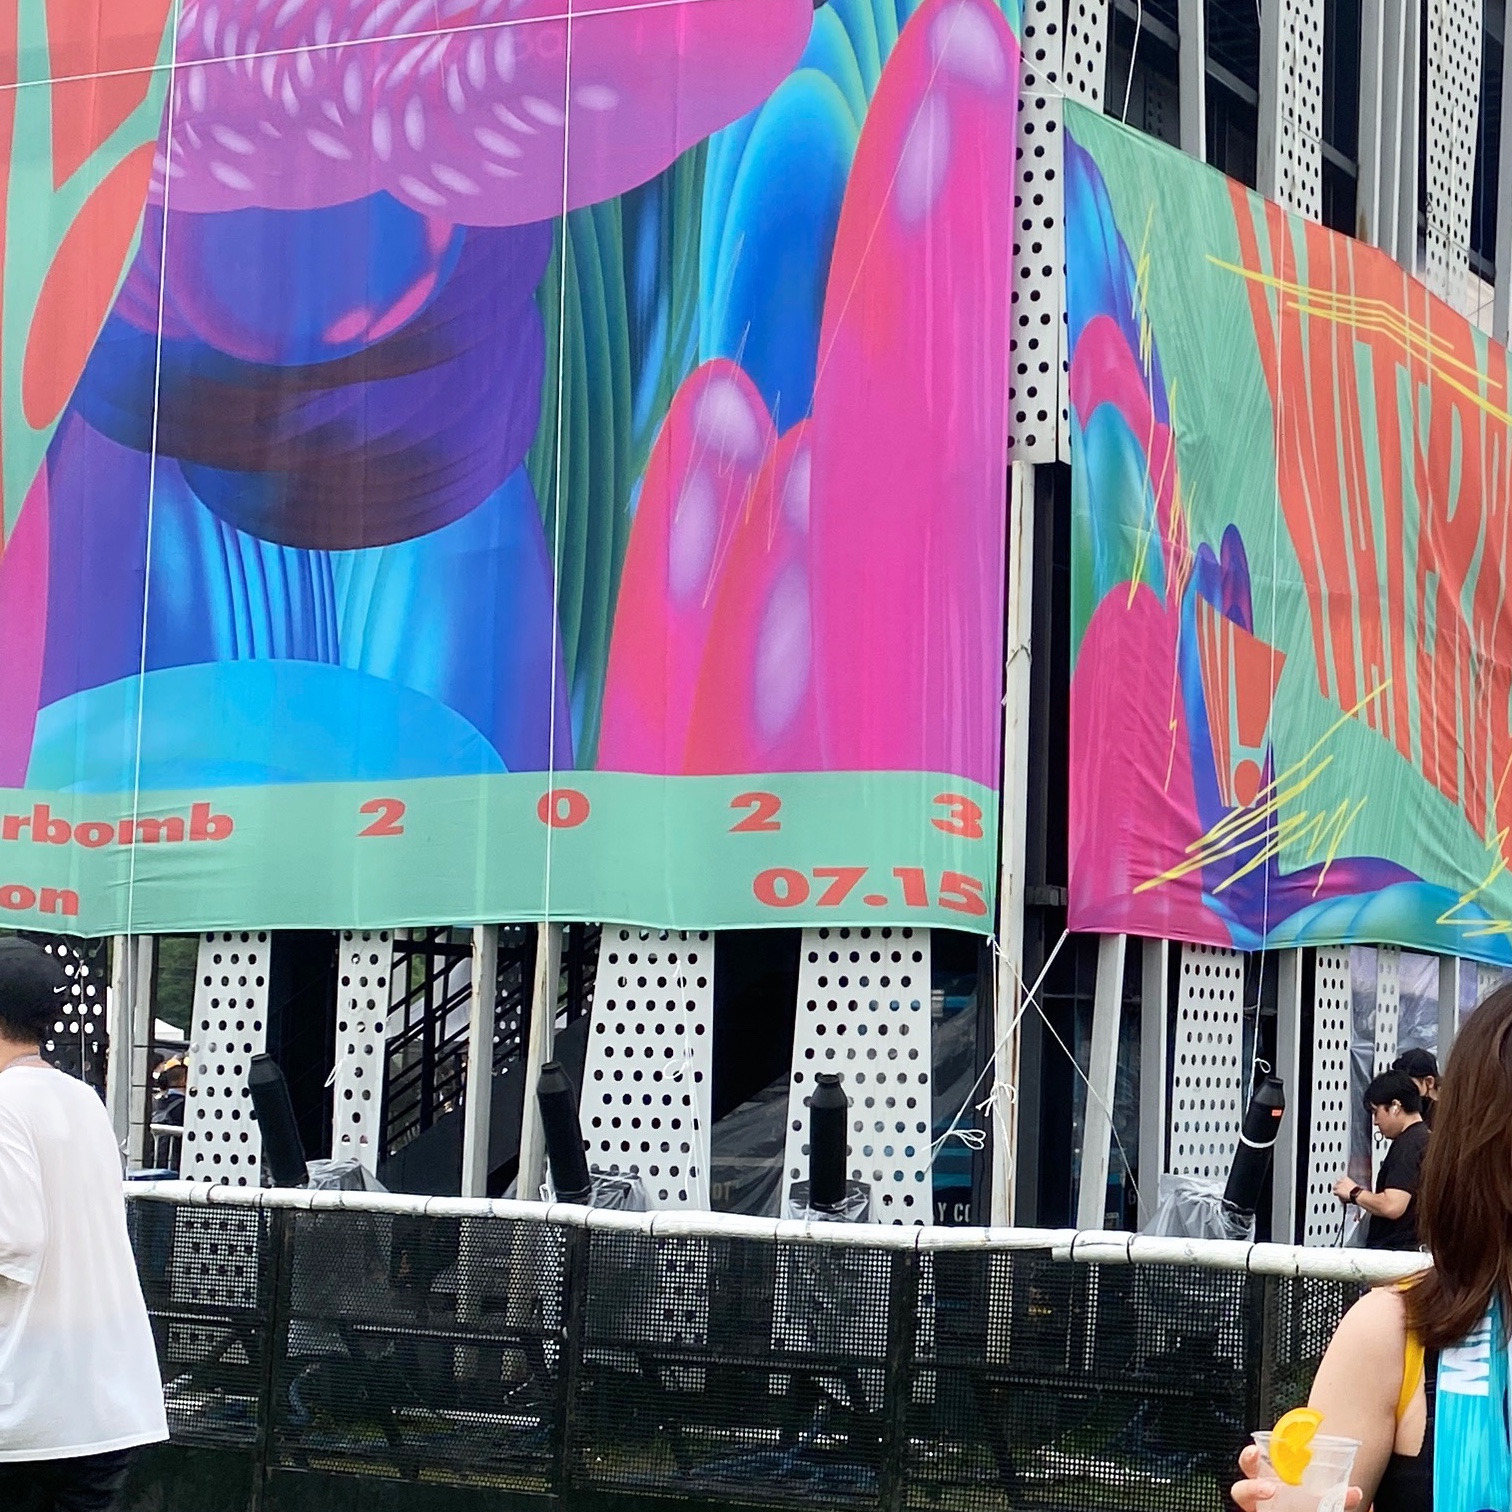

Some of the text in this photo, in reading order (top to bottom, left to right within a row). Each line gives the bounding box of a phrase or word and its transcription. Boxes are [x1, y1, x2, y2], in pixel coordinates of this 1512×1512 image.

[2, 800, 234, 848] rbomb
[0, 866, 988, 917] on 07.15
